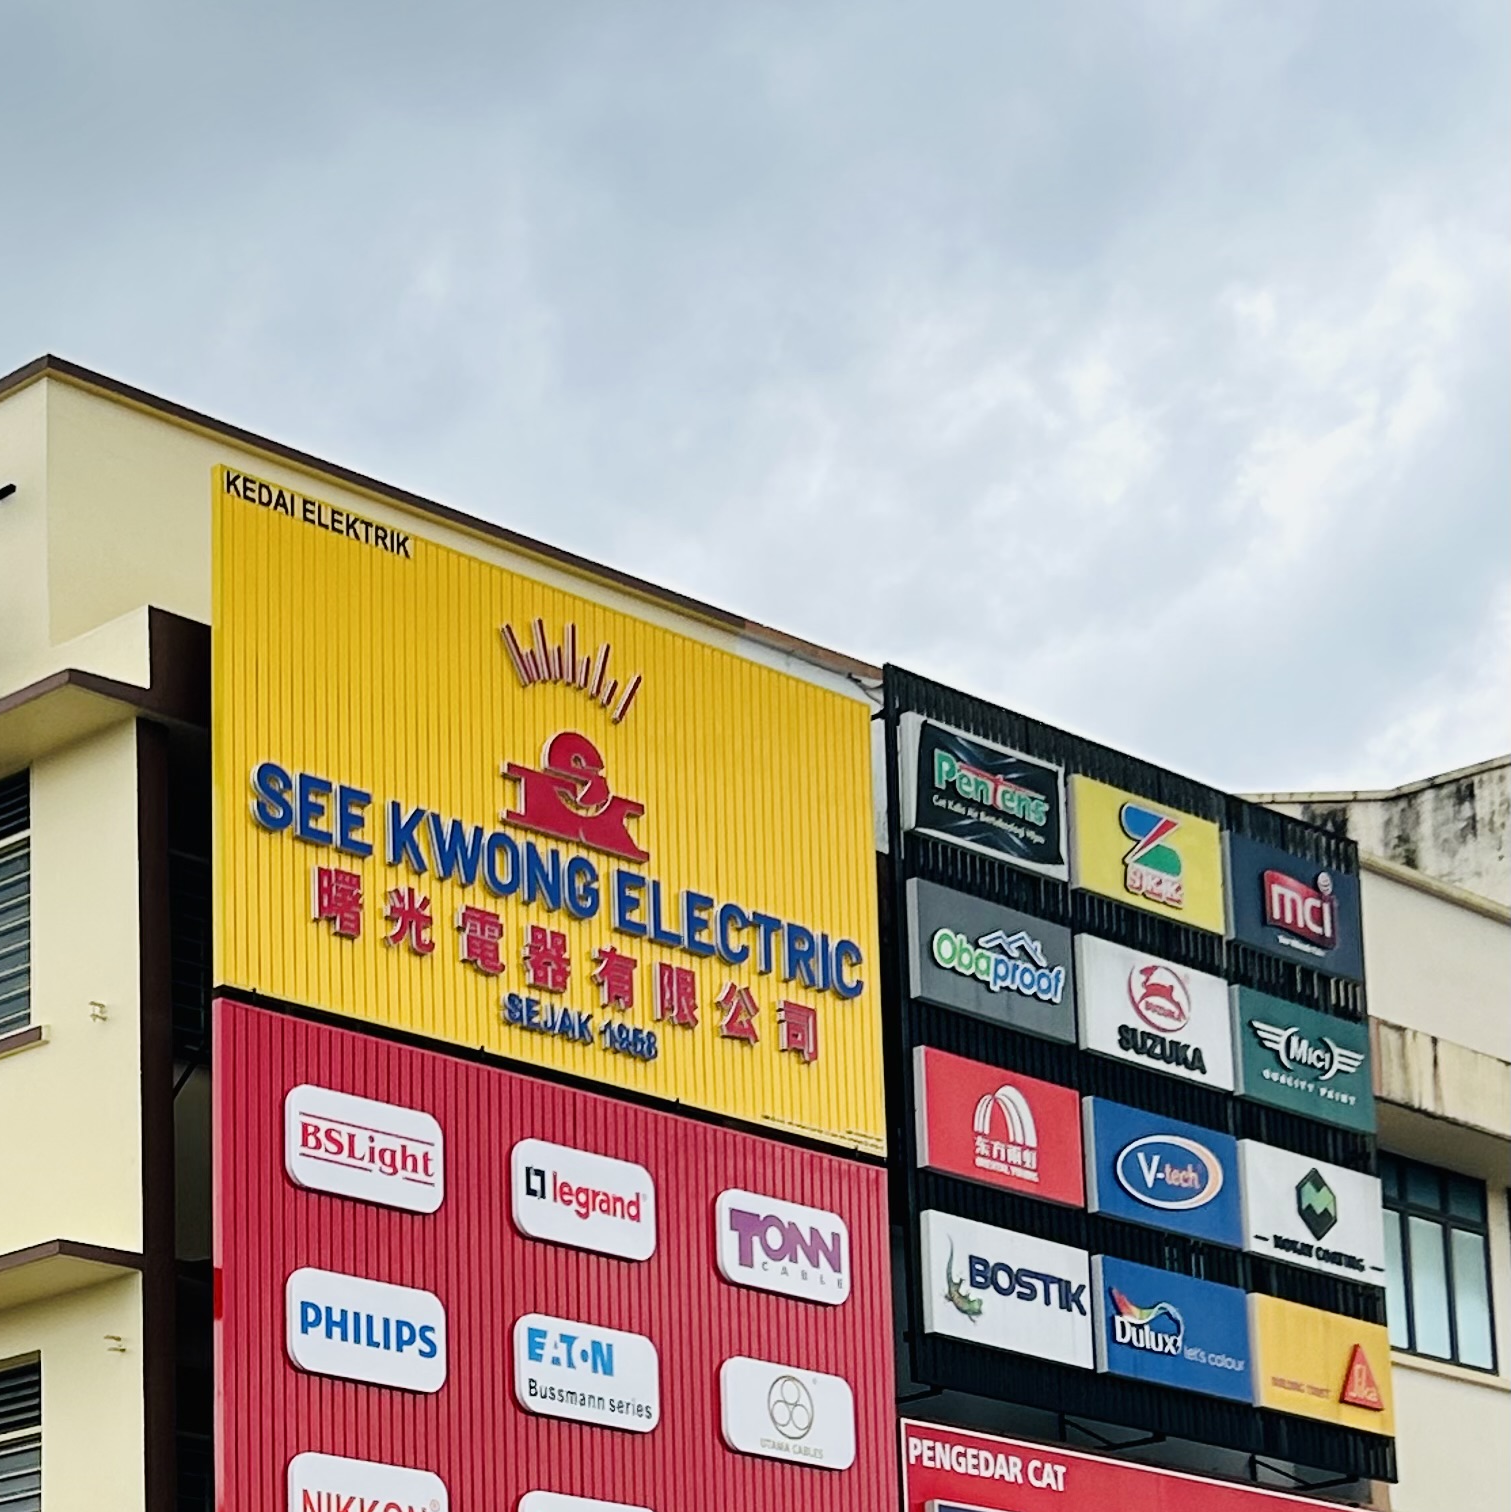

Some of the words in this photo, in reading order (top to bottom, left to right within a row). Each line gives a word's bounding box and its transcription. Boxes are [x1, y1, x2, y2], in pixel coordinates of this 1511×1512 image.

[226, 470, 295, 517] KEDAI
[303, 498, 410, 559] ELEKTRIK
[934, 748, 1050, 826] Pentens
[250, 762, 372, 859] SEE
[386, 800, 600, 920] KWONG
[611, 868, 864, 1000] ELECTRIC
[312, 866, 818, 1066] 曙光電器有限公司
[934, 928, 1066, 1004] Obaproof
[503, 993, 594, 1046] SEJAK
[599, 1019, 658, 1062] 1958
[1118, 1024, 1206, 1074] SUZUKA
[300, 1121, 435, 1178] BSLight
[1136, 1152, 1200, 1190] V-tech
[552, 1171, 642, 1221] legrand
[729, 1207, 842, 1274] TONN
[761, 1261, 843, 1289] CABLE
[969, 1254, 1087, 1316] BOSTIK
[300, 1301, 438, 1359] PHILIPS
[527, 1327, 614, 1377] EATON
[1115, 1315, 1178, 1356] Dulux
[528, 1379, 606, 1411] Bussmann
[609, 1397, 652, 1420] series
[908, 1437, 1022, 1486] PENGEDAR
[1027, 1459, 1067, 1492] CAT
